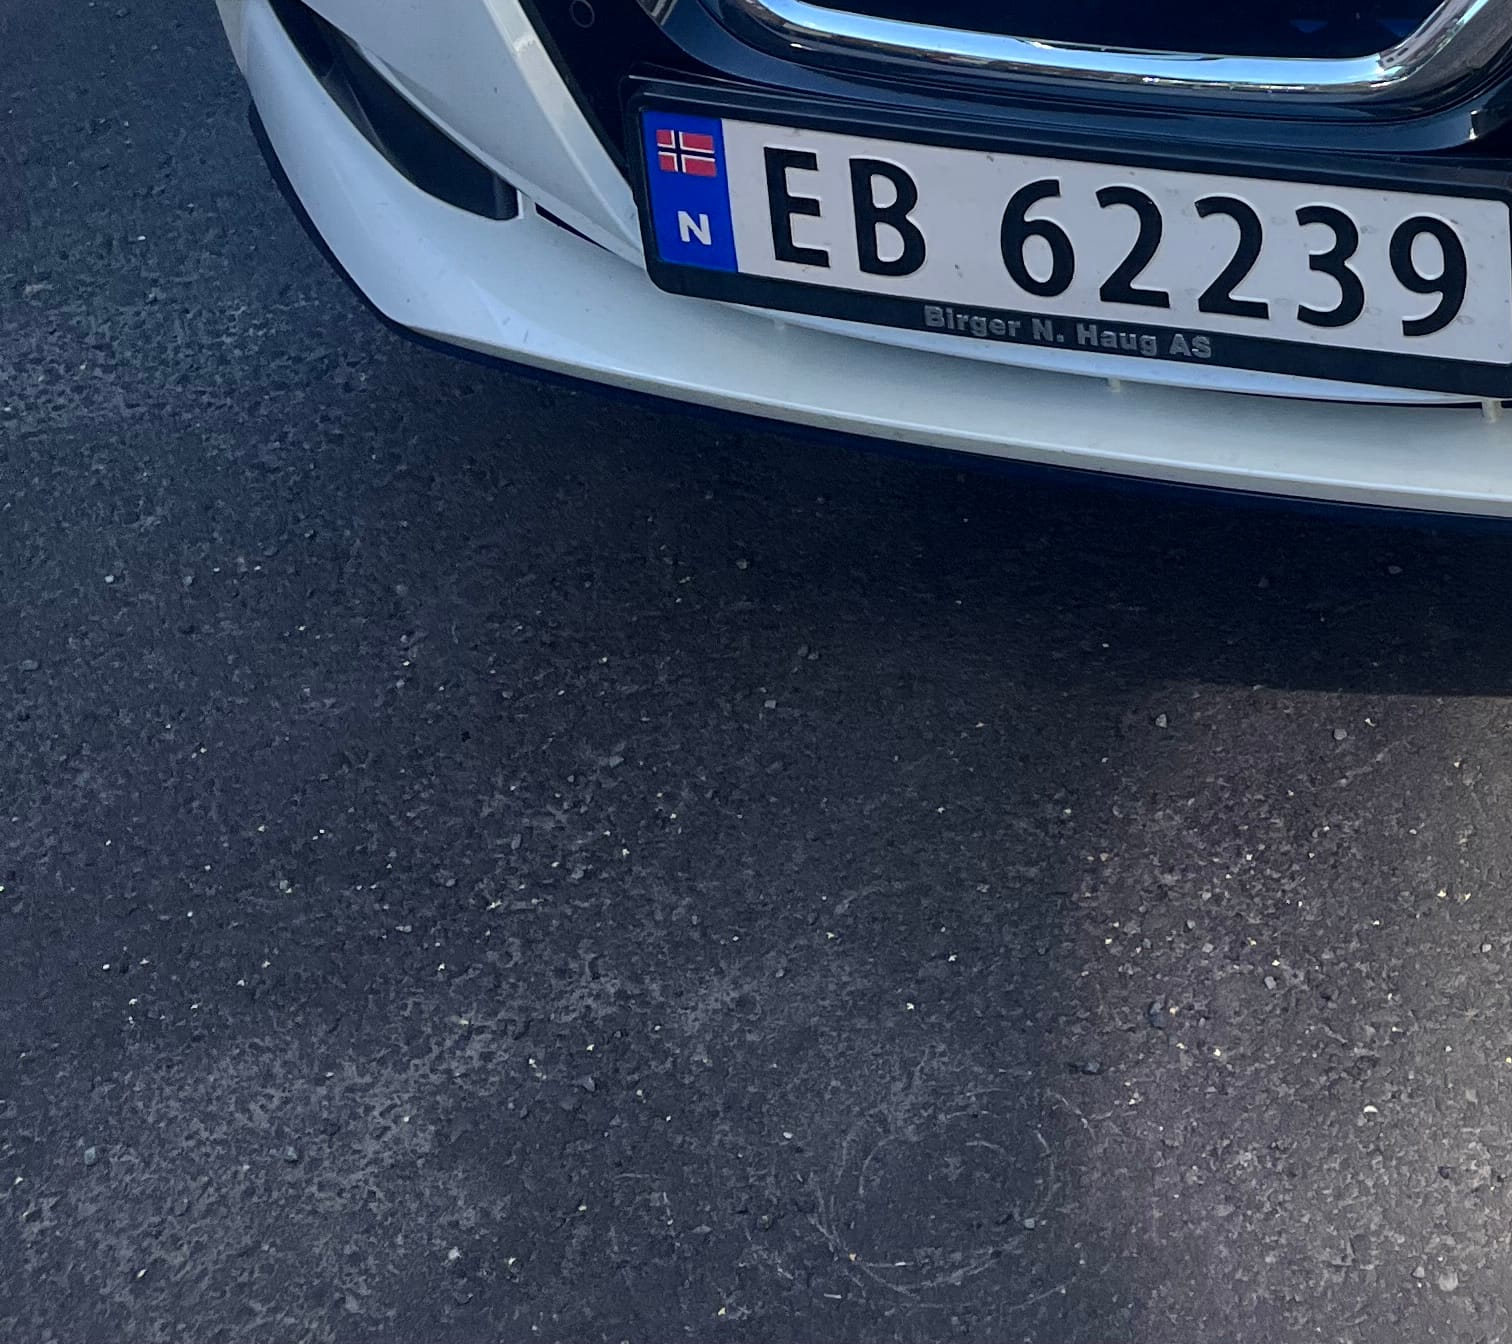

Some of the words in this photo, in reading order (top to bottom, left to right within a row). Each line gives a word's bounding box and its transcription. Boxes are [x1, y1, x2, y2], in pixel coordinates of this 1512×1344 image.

[678, 210, 712, 246] N
[764, 146, 927, 277] EB
[1000, 178, 1468, 337] 62239
[924, 305, 1021, 337] Birger
[1031, 318, 1065, 343] N.
[1076, 322, 1158, 357] Haug
[1168, 333, 1212, 359] AS
